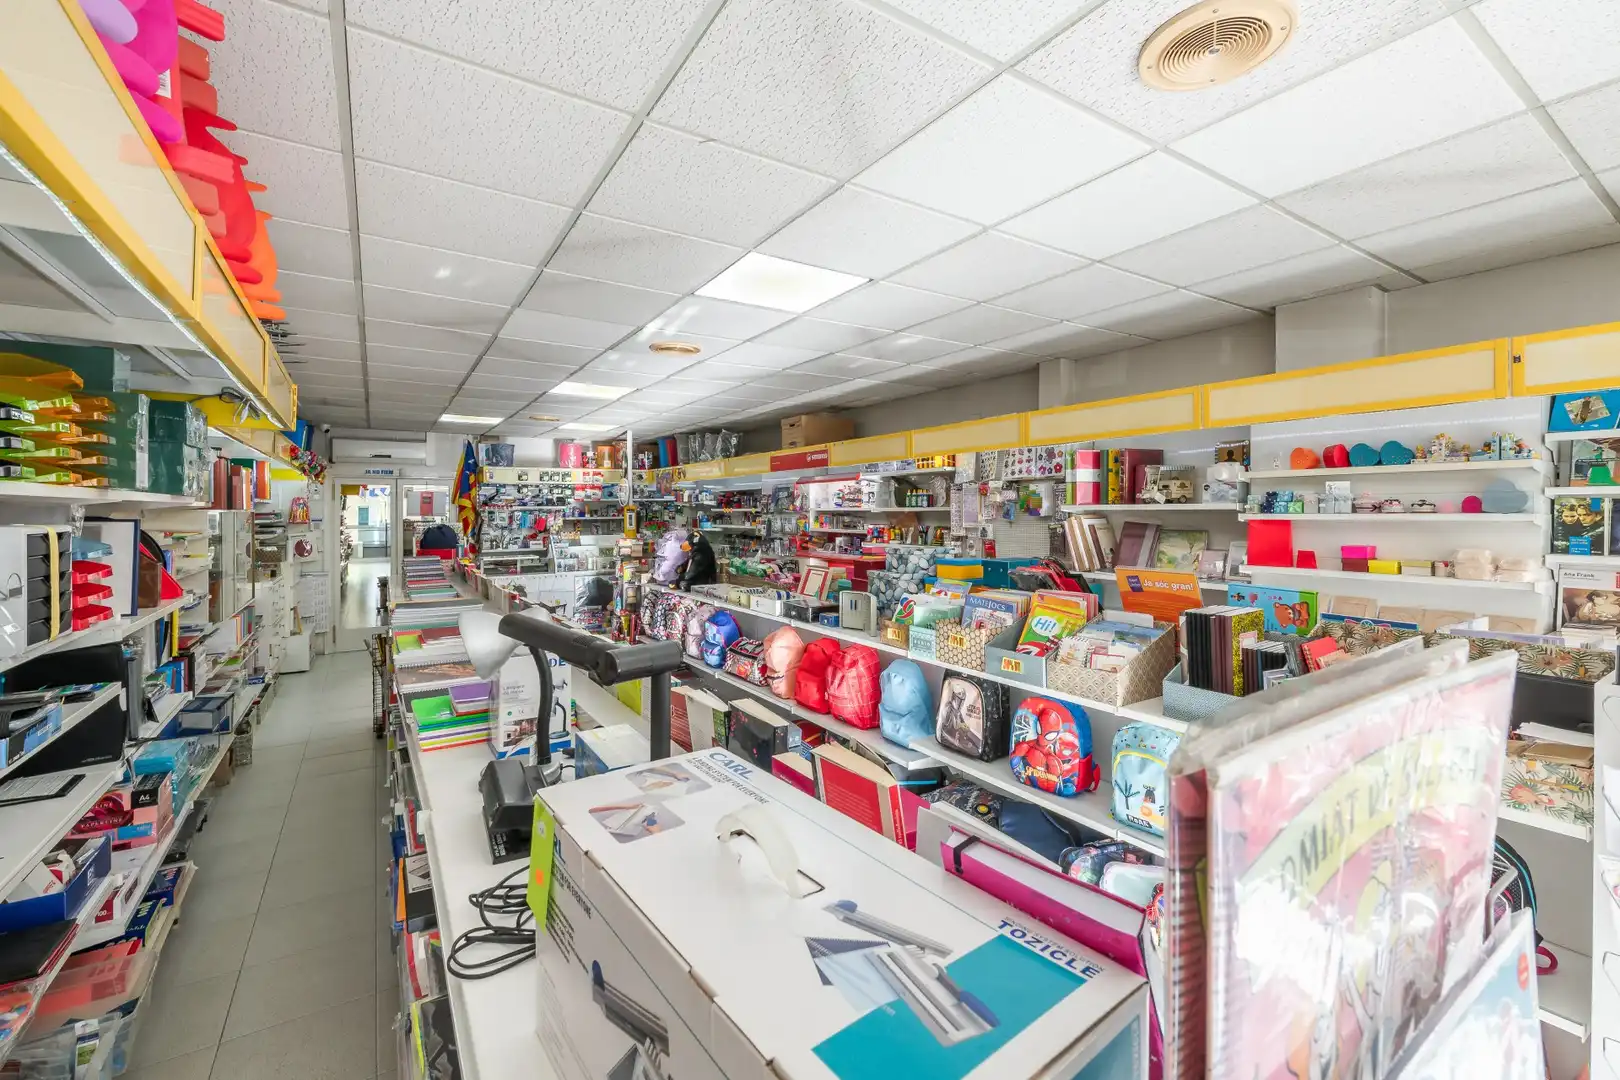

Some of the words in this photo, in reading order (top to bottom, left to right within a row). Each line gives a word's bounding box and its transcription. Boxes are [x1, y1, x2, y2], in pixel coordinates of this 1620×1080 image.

[1171, 582, 1194, 592] gran!
[970, 597, 1006, 611] MATEJOCS
[1034, 617, 1057, 633] Hi!
[548, 658, 566, 667] DE
[709, 752, 753, 780] CARL
[139, 794, 151, 802] A4
[998, 920, 1101, 979] TOZICLE
